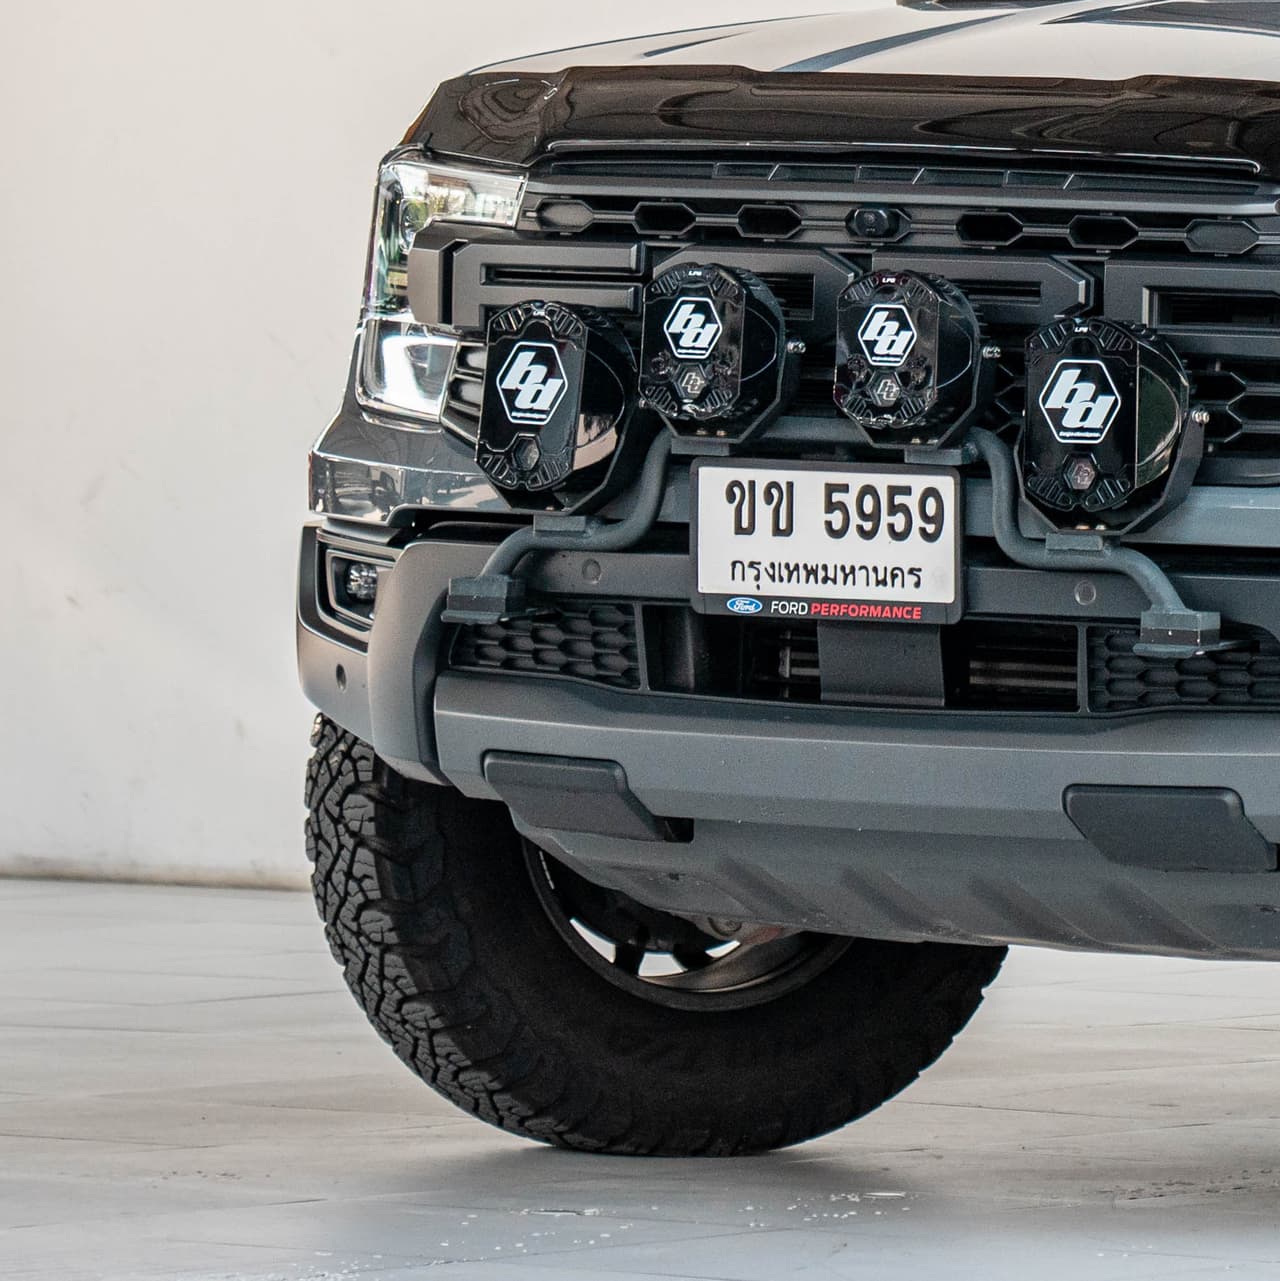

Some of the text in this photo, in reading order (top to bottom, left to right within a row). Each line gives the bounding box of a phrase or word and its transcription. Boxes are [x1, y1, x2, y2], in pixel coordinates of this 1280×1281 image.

[725, 479, 945, 543] ขข 5959
[730, 559, 922, 590] กรุงเทพมหานคร
[770, 600, 808, 615] FORD
[810, 602, 922, 619] PERFORMANCE
